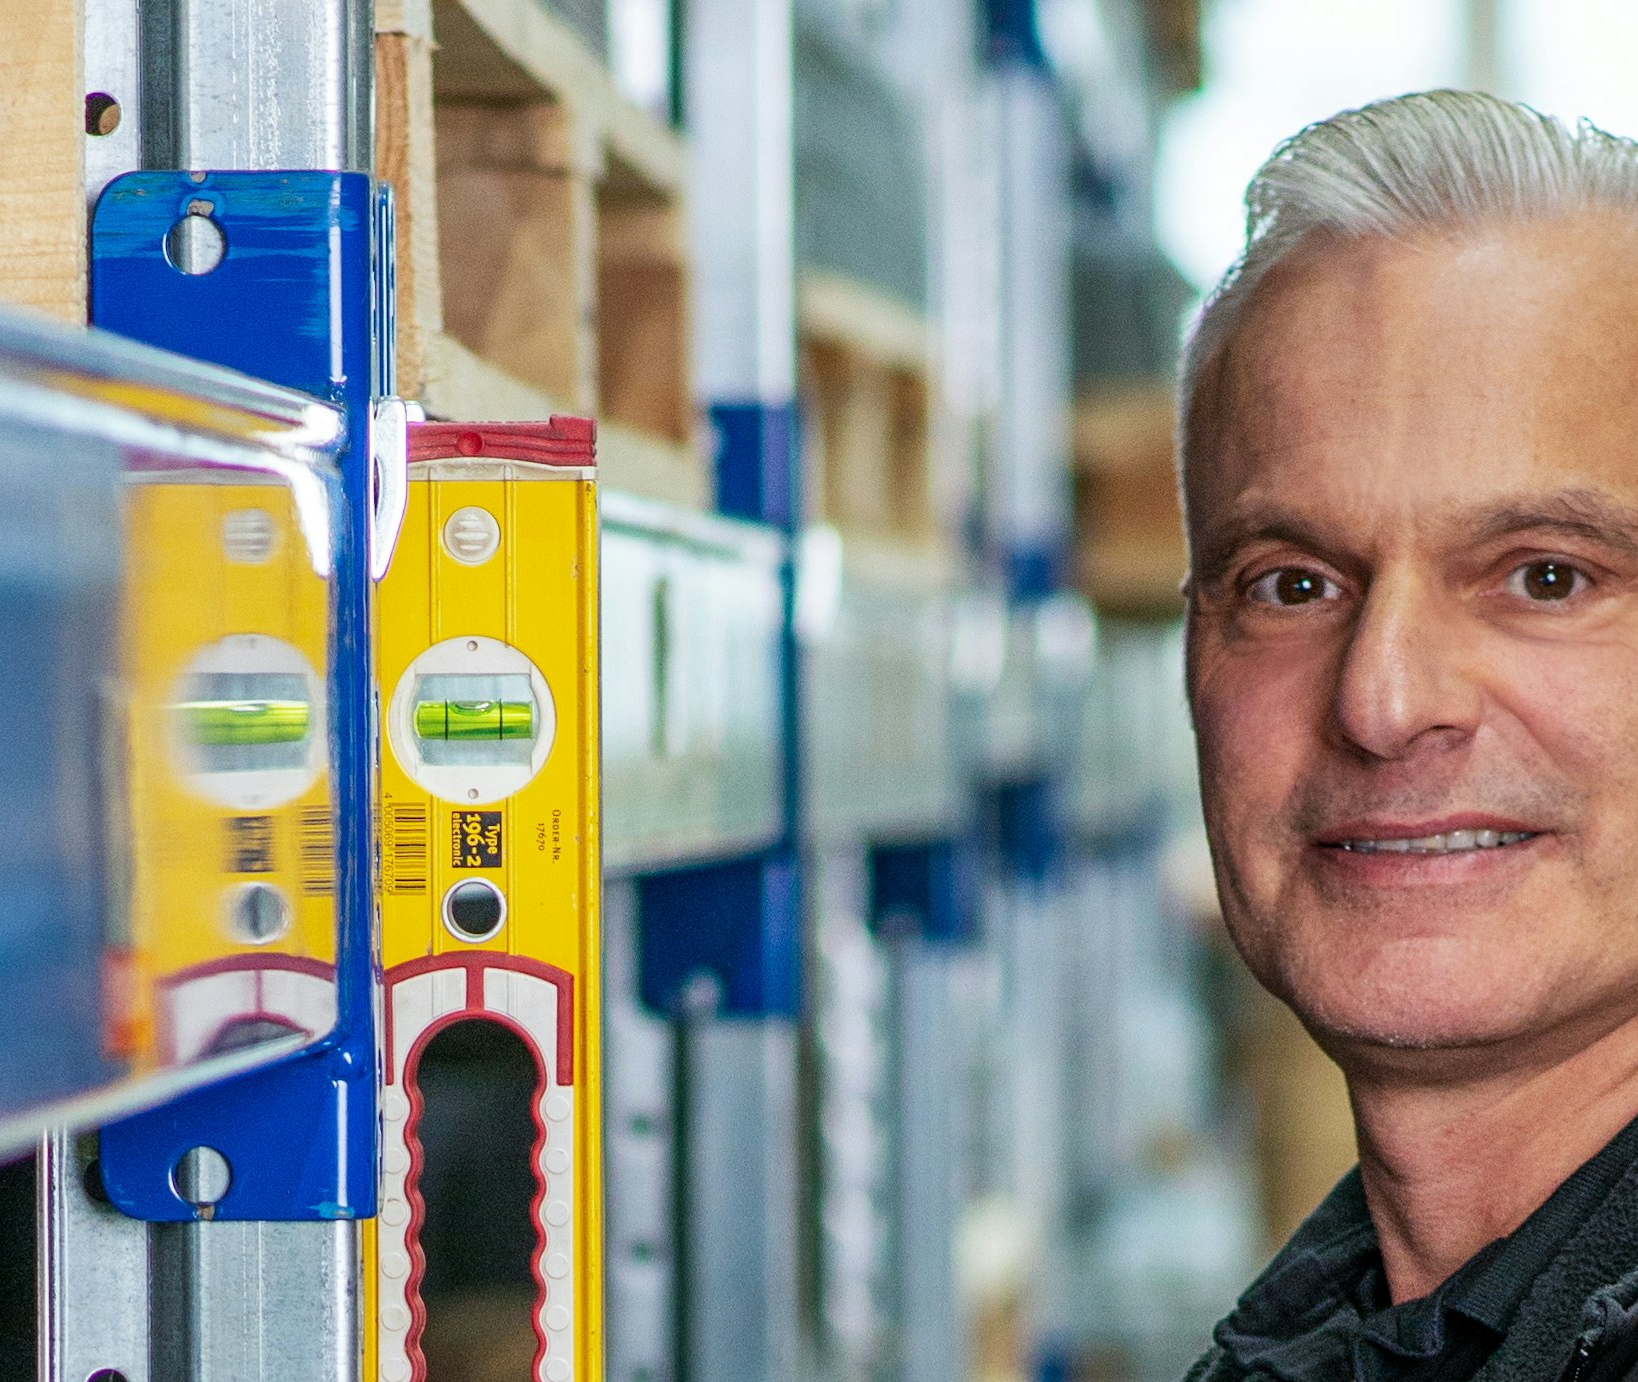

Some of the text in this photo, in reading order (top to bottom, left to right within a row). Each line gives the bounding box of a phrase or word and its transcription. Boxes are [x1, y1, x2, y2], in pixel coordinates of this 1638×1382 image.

[452, 812, 463, 866] electronic
[462, 813, 483, 867] 196-2
[486, 823, 501, 854] Type
[537, 822, 546, 851] 17670
